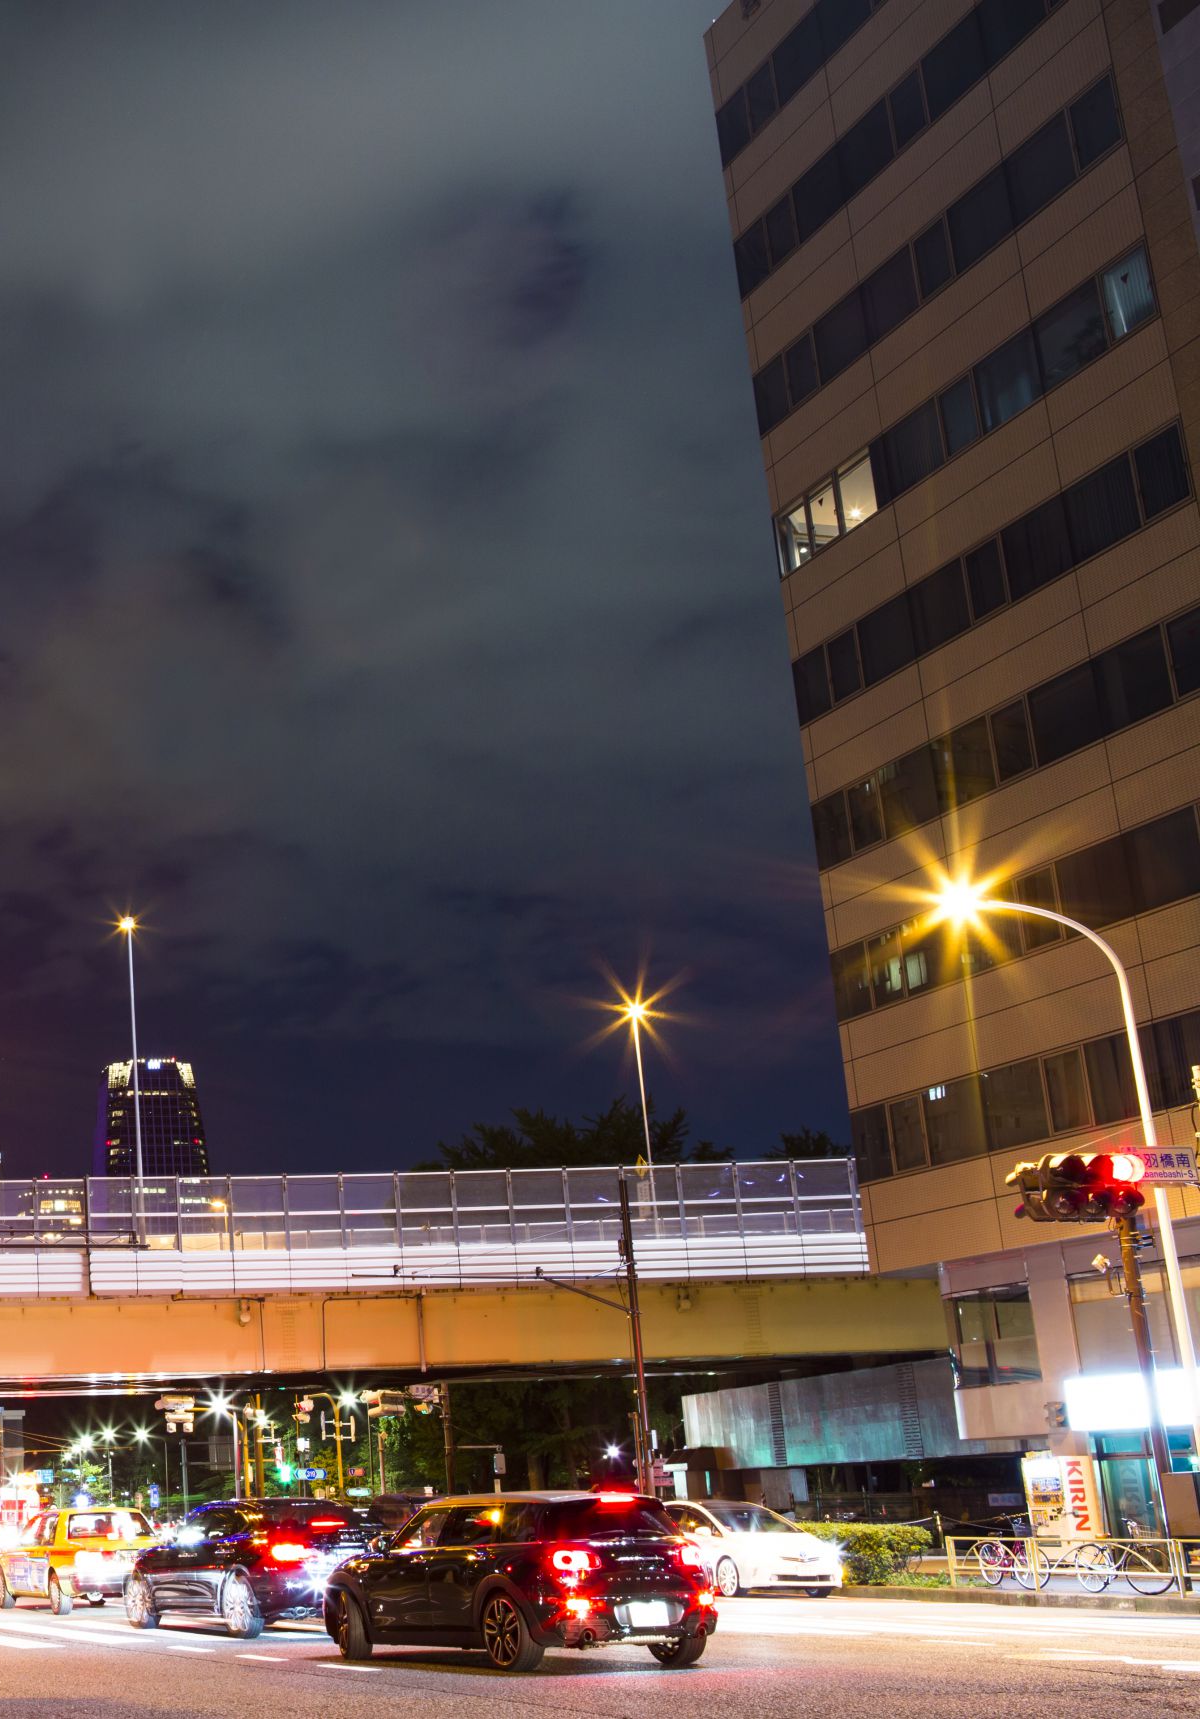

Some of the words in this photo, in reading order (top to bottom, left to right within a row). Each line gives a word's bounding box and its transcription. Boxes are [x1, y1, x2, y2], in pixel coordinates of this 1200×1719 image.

[1133, 1152, 1191, 1168] 羽橋南
[1066, 1460, 1091, 1532] KIRIN
